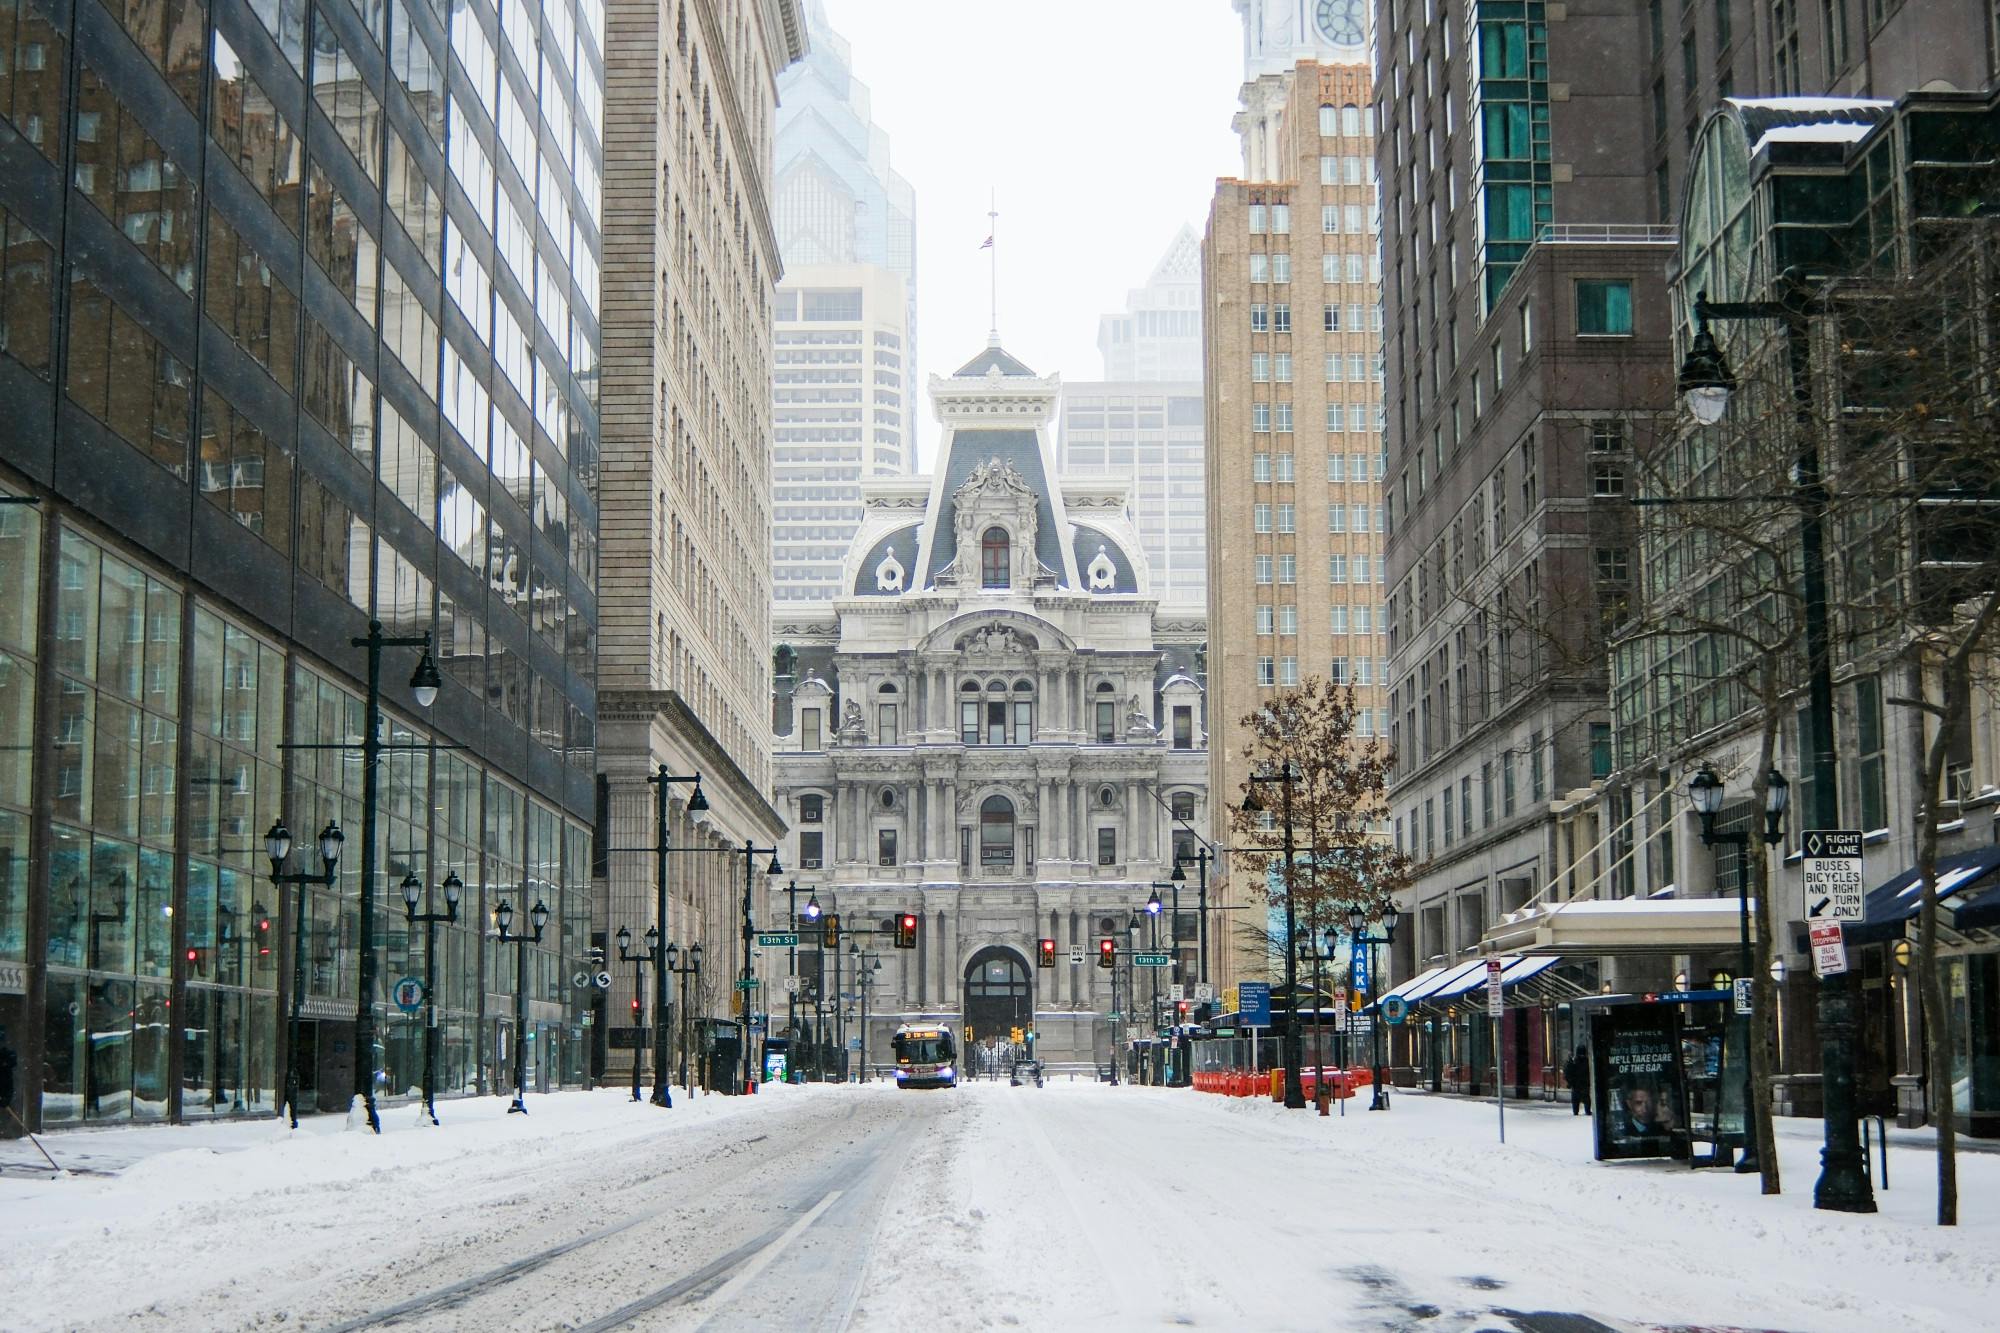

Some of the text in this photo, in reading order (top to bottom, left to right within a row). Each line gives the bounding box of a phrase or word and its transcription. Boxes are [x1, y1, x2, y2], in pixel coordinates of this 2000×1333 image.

[1825, 834, 1860, 844] RIGHT
[1829, 845, 1859, 855] LANE
[1815, 860, 1850, 871] BUSES
[1806, 872, 1860, 883] BICYCLES
[1808, 883, 1858, 894] AND RIGHT
[1835, 895, 1860, 905] TURN
[1834, 906, 1860, 917] ONLY
[762, 936, 794, 944] 13th St
[1812, 935, 1840, 946] STOPPING
[1821, 946, 1835, 954] BUS
[1355, 936, 1365, 986] ARK
[1821, 954, 1838, 964] ZONE
[1608, 1053, 1673, 1064] WE'LL TAKE CARE
[1619, 1065, 1628, 1073] OF
[1630, 1064, 1645, 1072] THE
